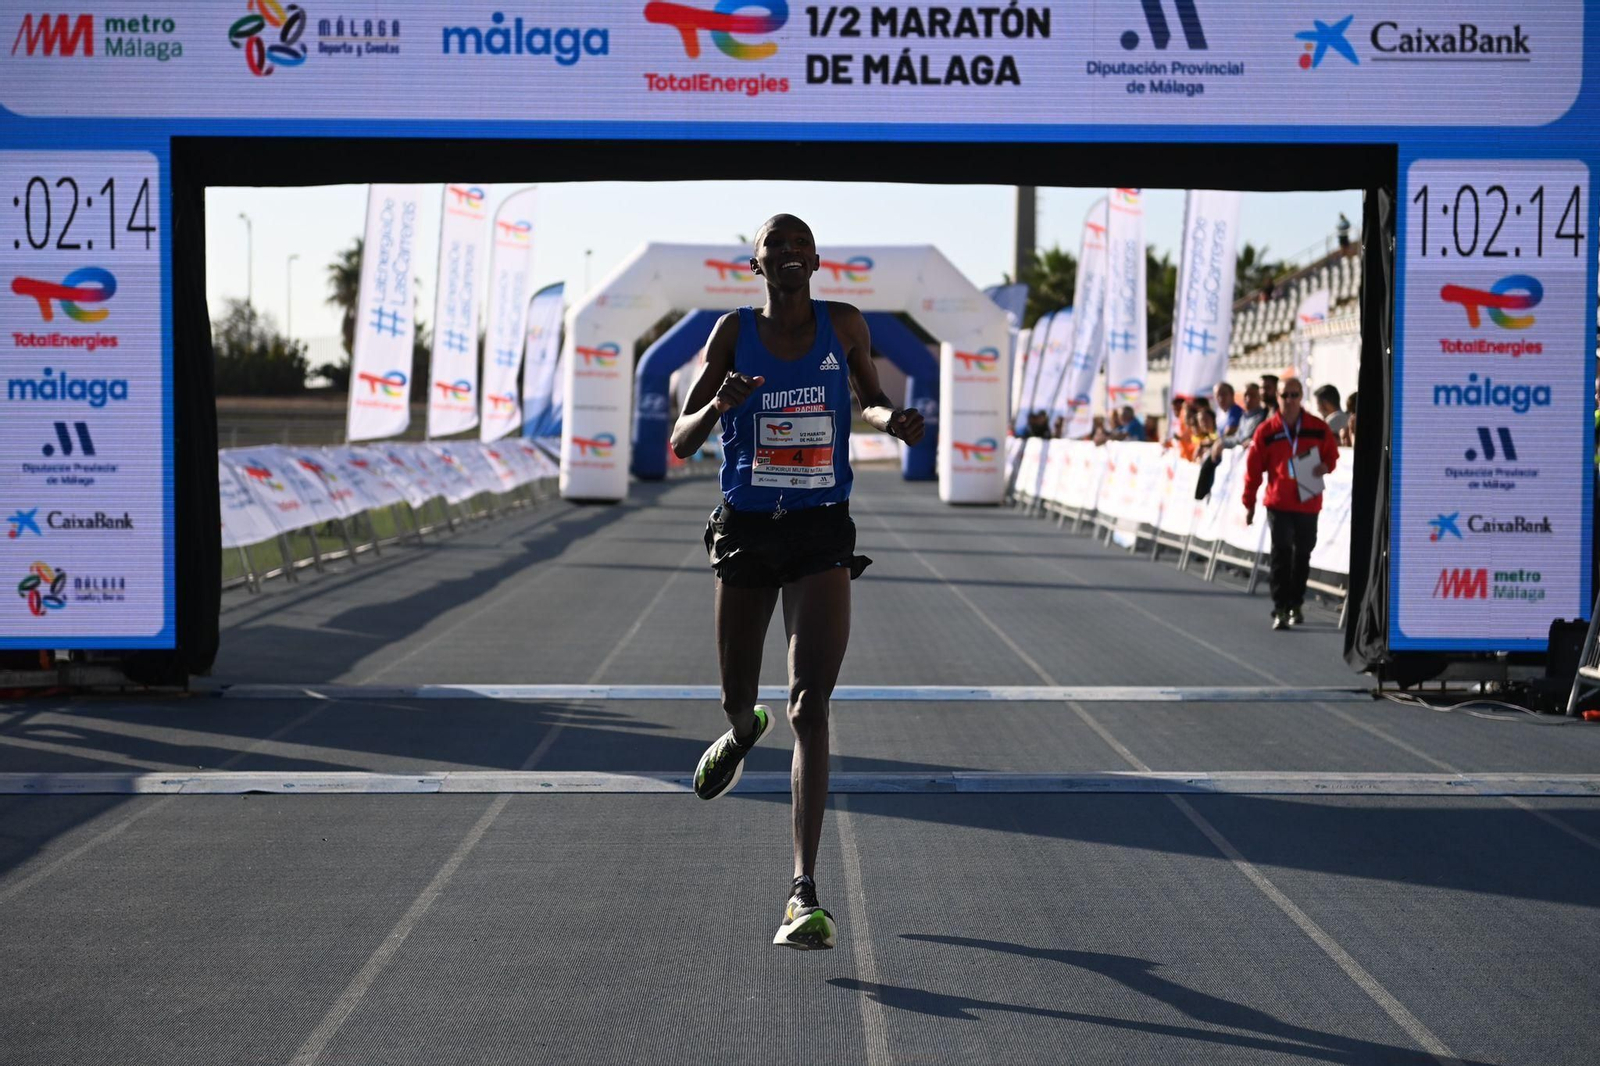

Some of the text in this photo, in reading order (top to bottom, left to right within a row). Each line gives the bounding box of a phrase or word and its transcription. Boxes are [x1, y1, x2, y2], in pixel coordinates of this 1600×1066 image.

[104, 15, 175, 33] metro
[318, 15, 400, 37] MÁLAGA
[805, 1, 1051, 38] 1/2 MARATÓN
[442, 12, 609, 66] málaga
[1370, 21, 1530, 54] CaixaBank
[105, 37, 182, 61] Málaga
[806, 48, 1021, 85] DE MÁLAGA
[1086, 60, 1244, 77] Diputación Provincial
[643, 73, 790, 97] TotalEnergies
[1127, 79, 1204, 96] de Málaga
[1413, 185, 1585, 258] 1:02:14
[12, 332, 118, 351] TotalEnergies
[1439, 338, 1543, 357] TotalEnergies
[820, 363, 840, 371] adidas
[8, 367, 128, 408] málaga
[1433, 372, 1551, 413] málaga
[795, 404, 823, 412] RACING
[793, 450, 803, 463] 4
[47, 511, 134, 529] CaixaBank
[1468, 515, 1552, 533] CaixaBank
[1494, 569, 1541, 582] metro
[1494, 585, 1545, 603] Málaga
